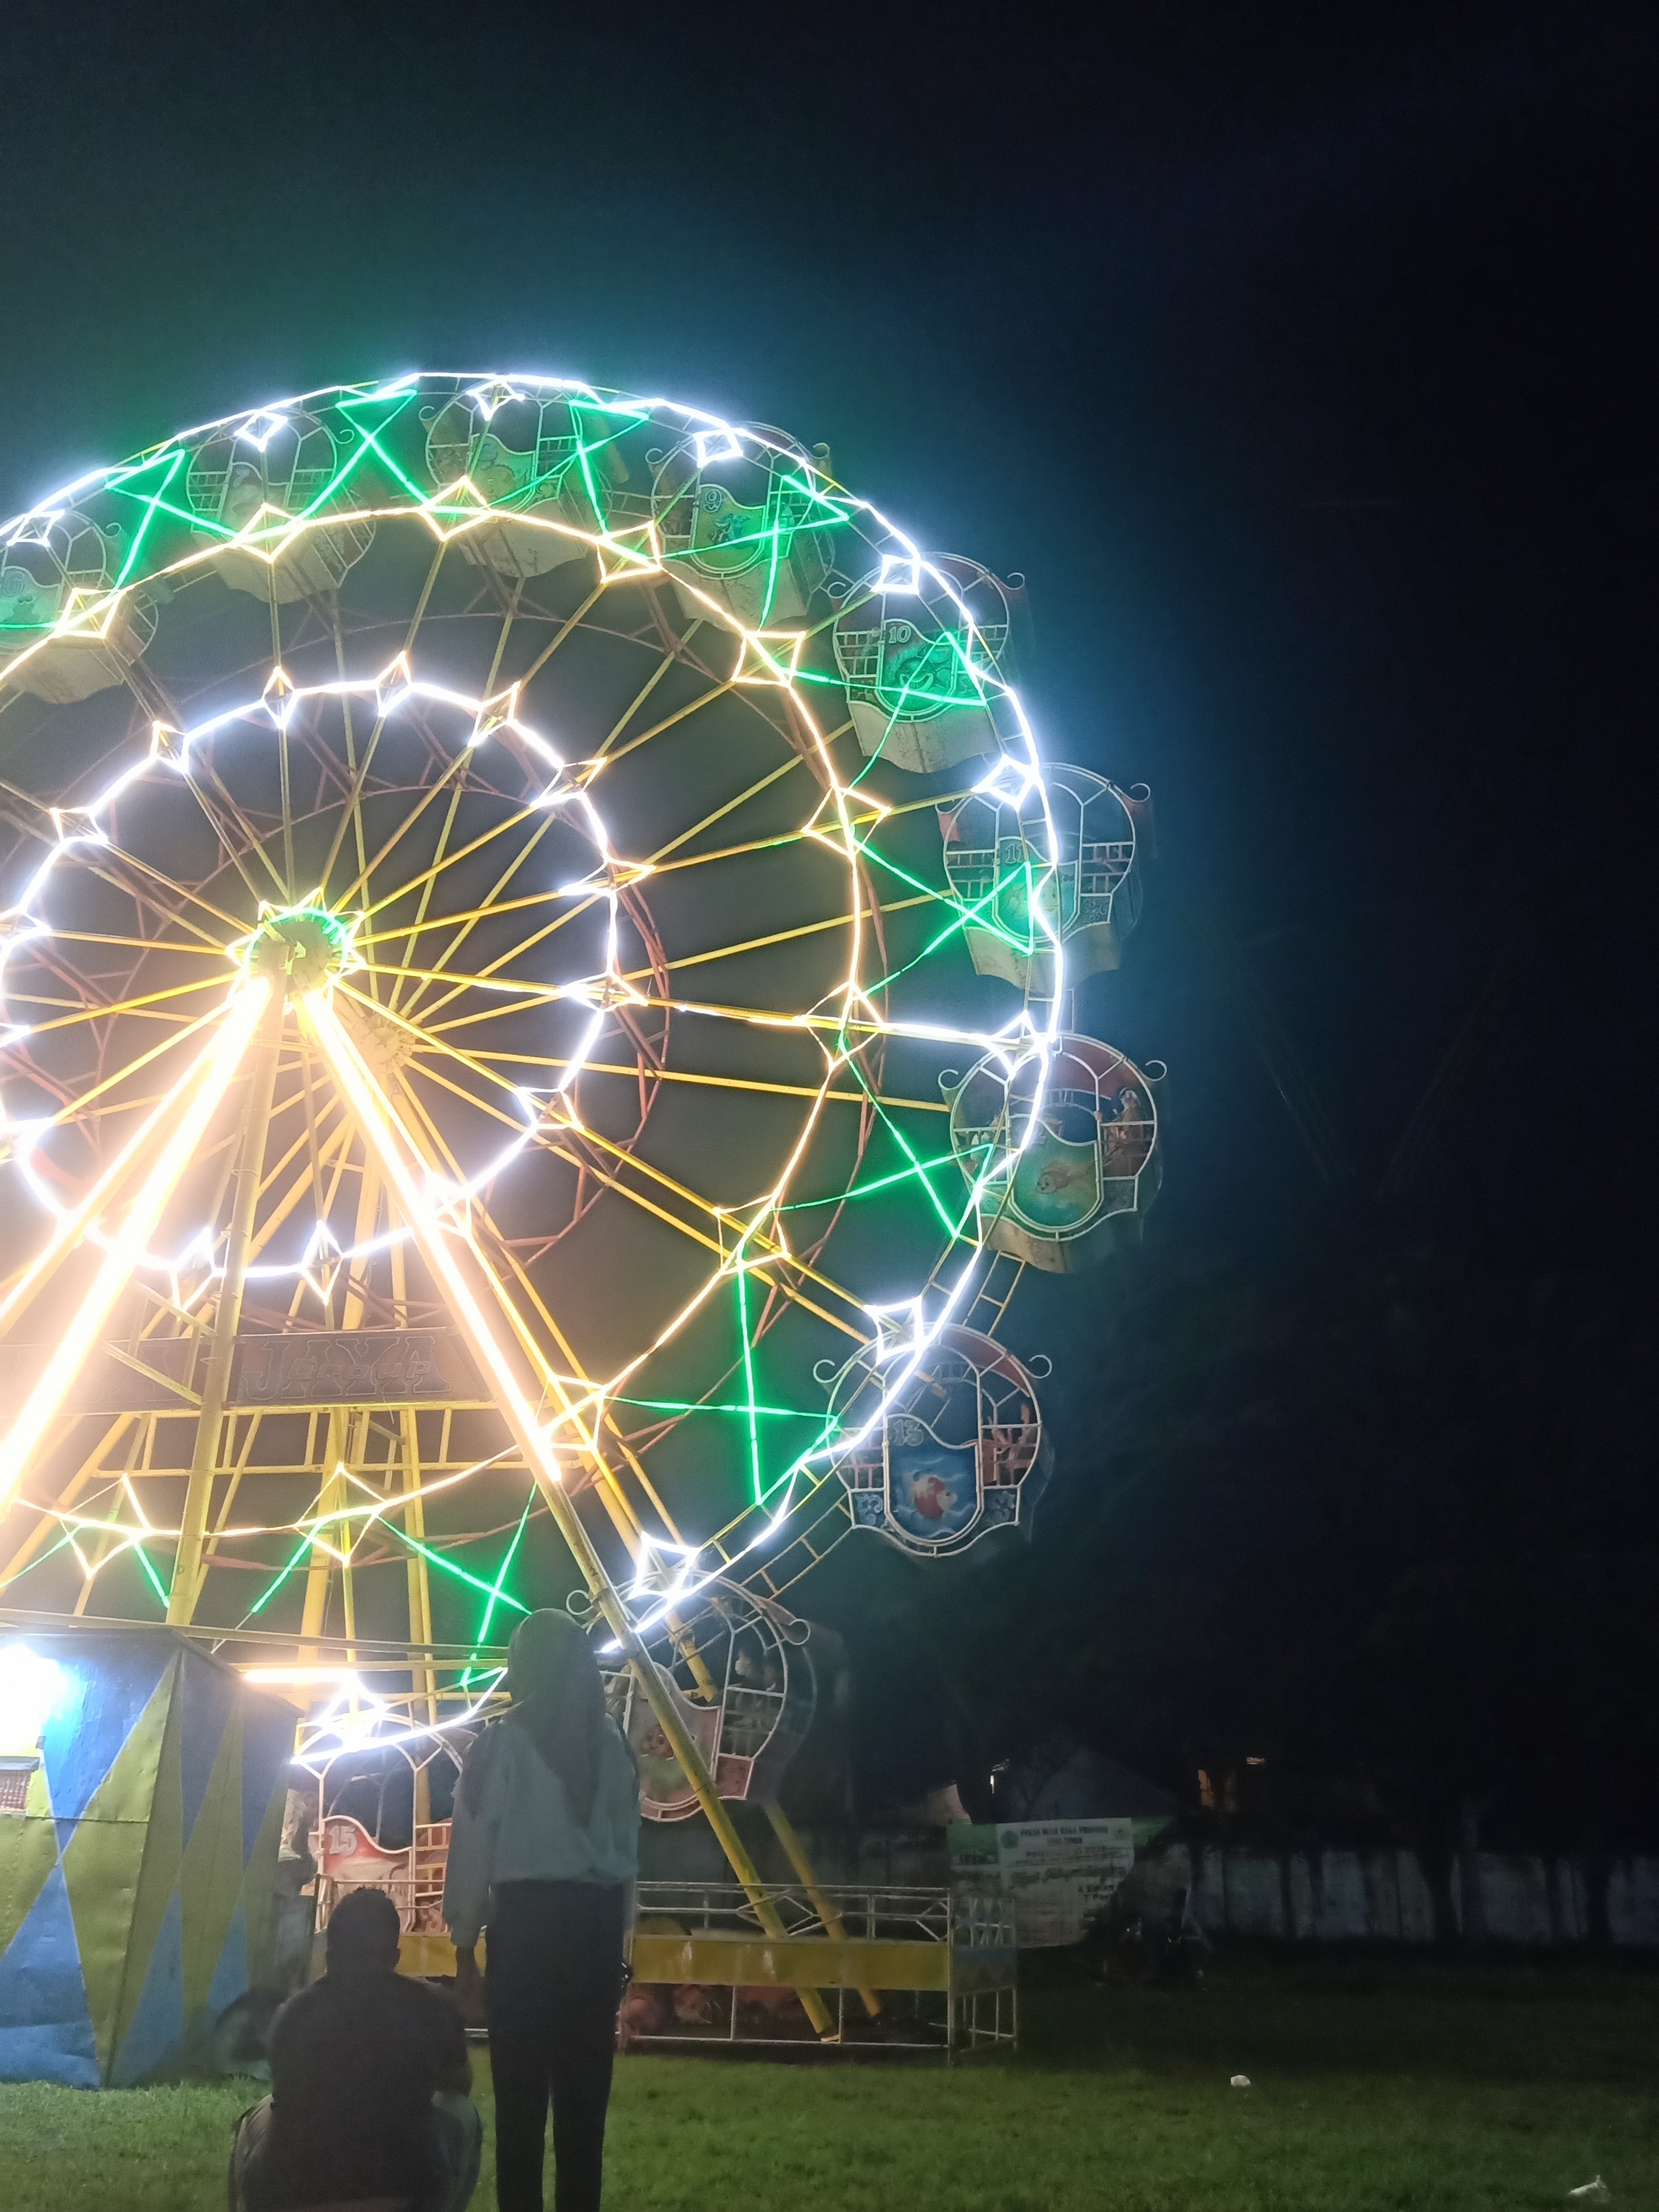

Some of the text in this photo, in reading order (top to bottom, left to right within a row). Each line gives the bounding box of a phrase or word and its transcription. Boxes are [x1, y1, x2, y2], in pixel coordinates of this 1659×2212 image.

[703, 489, 722, 513] 9
[888, 625, 911, 644] 10
[241, 1335, 452, 1400] JAYA
[328, 1824, 357, 1856] 15
